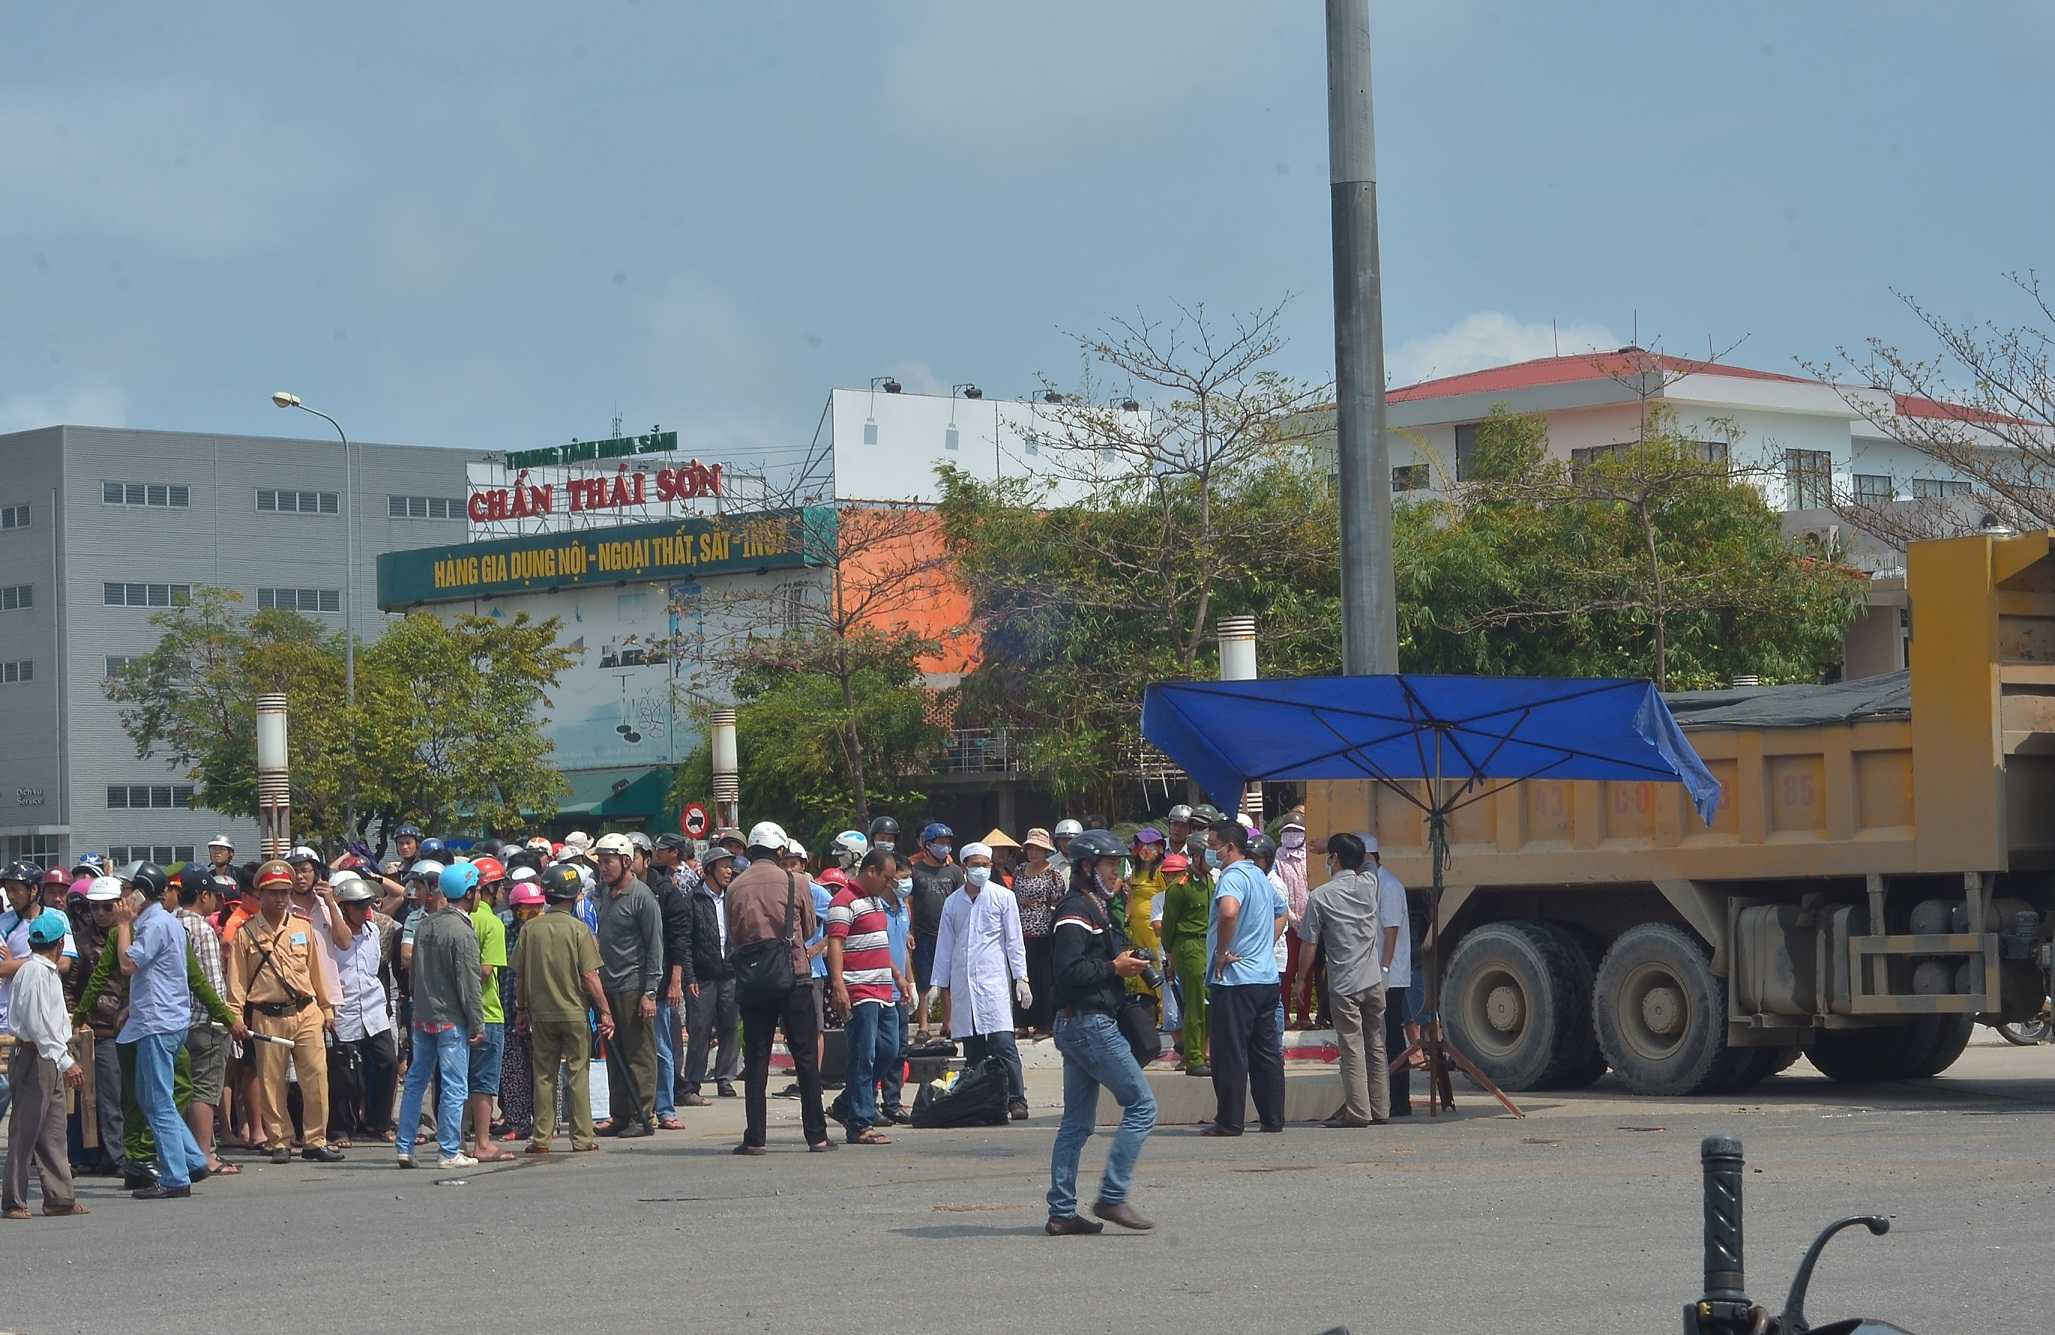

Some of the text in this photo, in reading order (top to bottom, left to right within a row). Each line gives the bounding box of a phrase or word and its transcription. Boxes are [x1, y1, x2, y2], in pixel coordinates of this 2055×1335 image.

[566, 463, 646, 512] THÁI
[434, 553, 478, 588] HÀNG
[481, 554, 508, 582] GIA
[511, 548, 556, 586] DỤNG
[558, 540, 587, 581] NỘI
[598, 537, 649, 574] NGOẠI
[652, 525, 697, 566] THẤT,
[700, 521, 731, 562] SẮT
